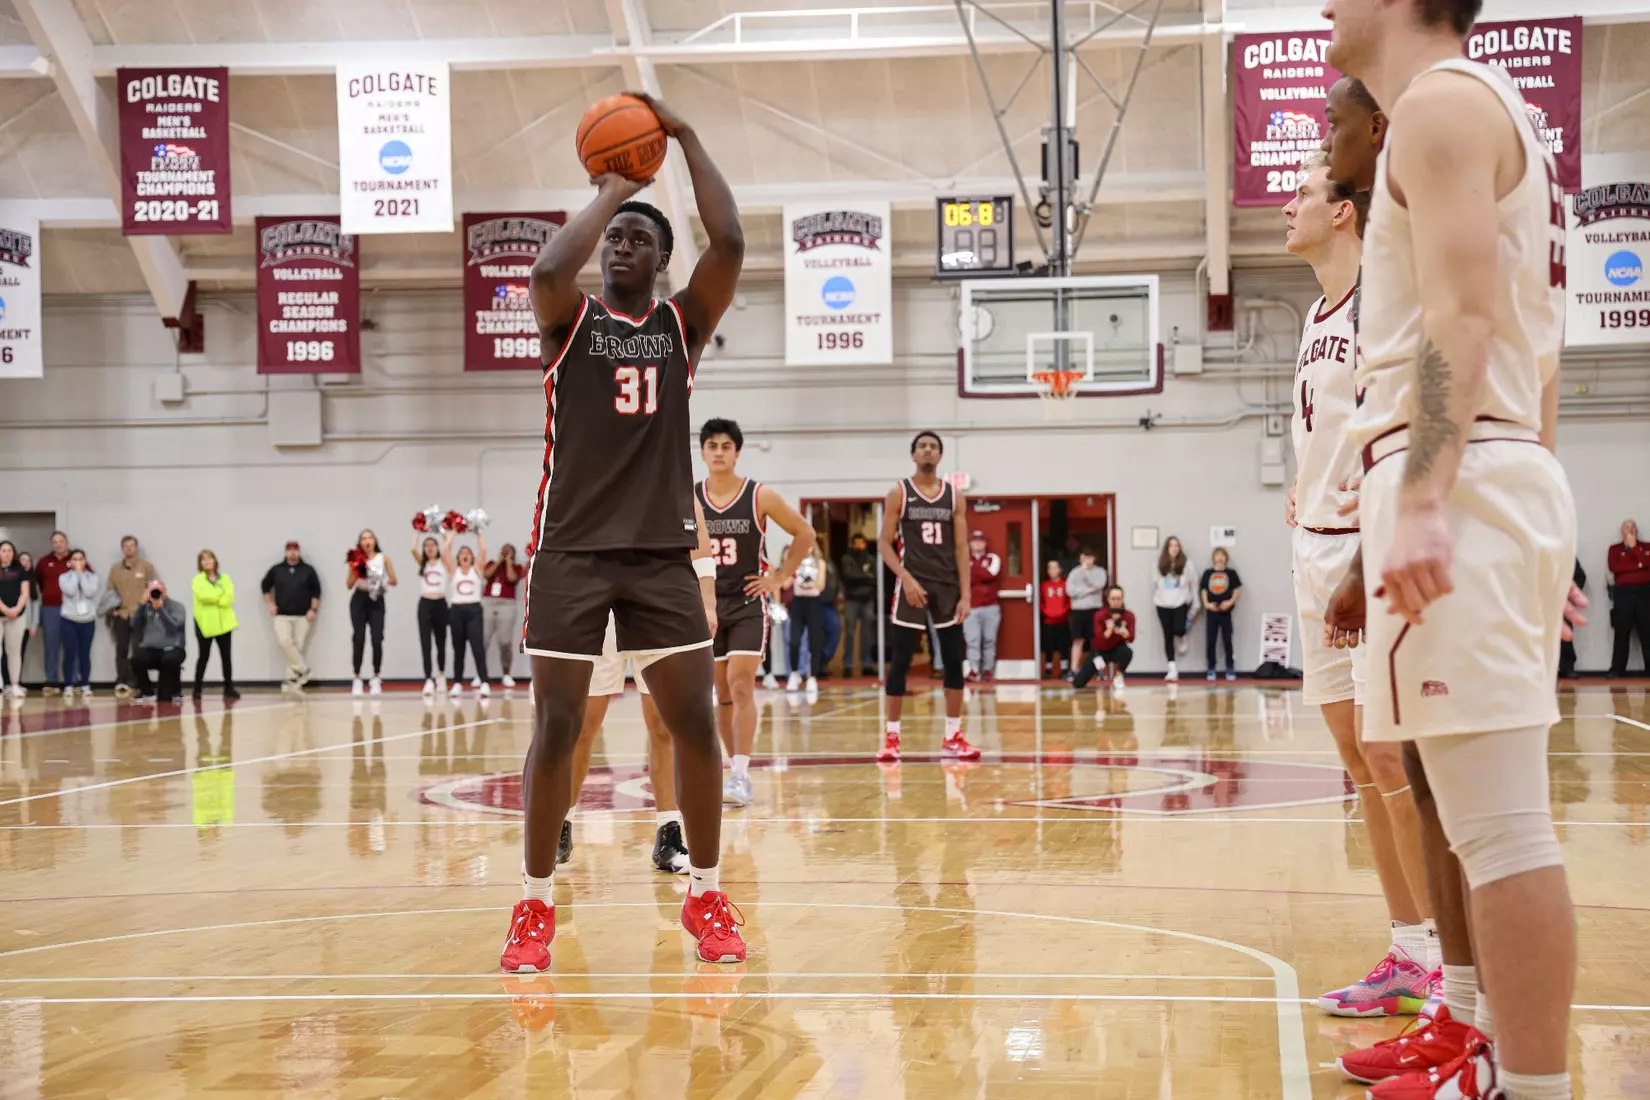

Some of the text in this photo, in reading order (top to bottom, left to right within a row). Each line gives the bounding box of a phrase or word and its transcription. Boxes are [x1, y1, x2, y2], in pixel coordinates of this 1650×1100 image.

[1468, 26, 1572, 59] COLGATE
[1243, 37, 1333, 69] COLGAT
[1488, 55, 1551, 68] RAIDERS
[1263, 67, 1324, 79] RAIDERS
[127, 74, 219, 103] COLGATE
[349, 72, 437, 98] COLGATE
[1512, 75, 1555, 89] EYBALL
[1259, 86, 1327, 100] VOLLEYBALL
[146, 102, 202, 113] RAIDERS
[157, 115, 191, 127] MEN'S
[142, 126, 207, 139] BASKETBALL
[1296, 139, 1322, 150] SEAS
[1250, 151, 1314, 166] CHAMPI
[136, 170, 215, 183] TOURNAMENT
[136, 182, 216, 196] CHAMPIONS
[353, 179, 439, 192] TOURNAMENT
[133, 199, 220, 222] 2020-21
[374, 199, 419, 217] 2021
[272, 268, 343, 280] VOLLEYBALL
[480, 265, 533, 277] VOLLEYB
[277, 291, 339, 305] REGULAR
[282, 305, 335, 319] SEASON
[476, 310, 537, 322] TOURNAM
[1600, 309, 1650, 329] 1999
[270, 319, 348, 333] CHAMPIONS
[796, 313, 882, 326] TOURNAMENT
[476, 321, 540, 334] CHAMPIO
[589, 330, 673, 359] BROWN
[817, 331, 864, 350] 1996
[286, 341, 335, 361] 1996
[493, 338, 541, 358] 1996
[614, 366, 658, 415] 31
[1301, 379, 1314, 432] 4
[705, 519, 751, 535] ROWN
[921, 521, 943, 545] 21
[710, 537, 737, 566] 23
[424, 571, 441, 587] C
[457, 580, 474, 595] C
